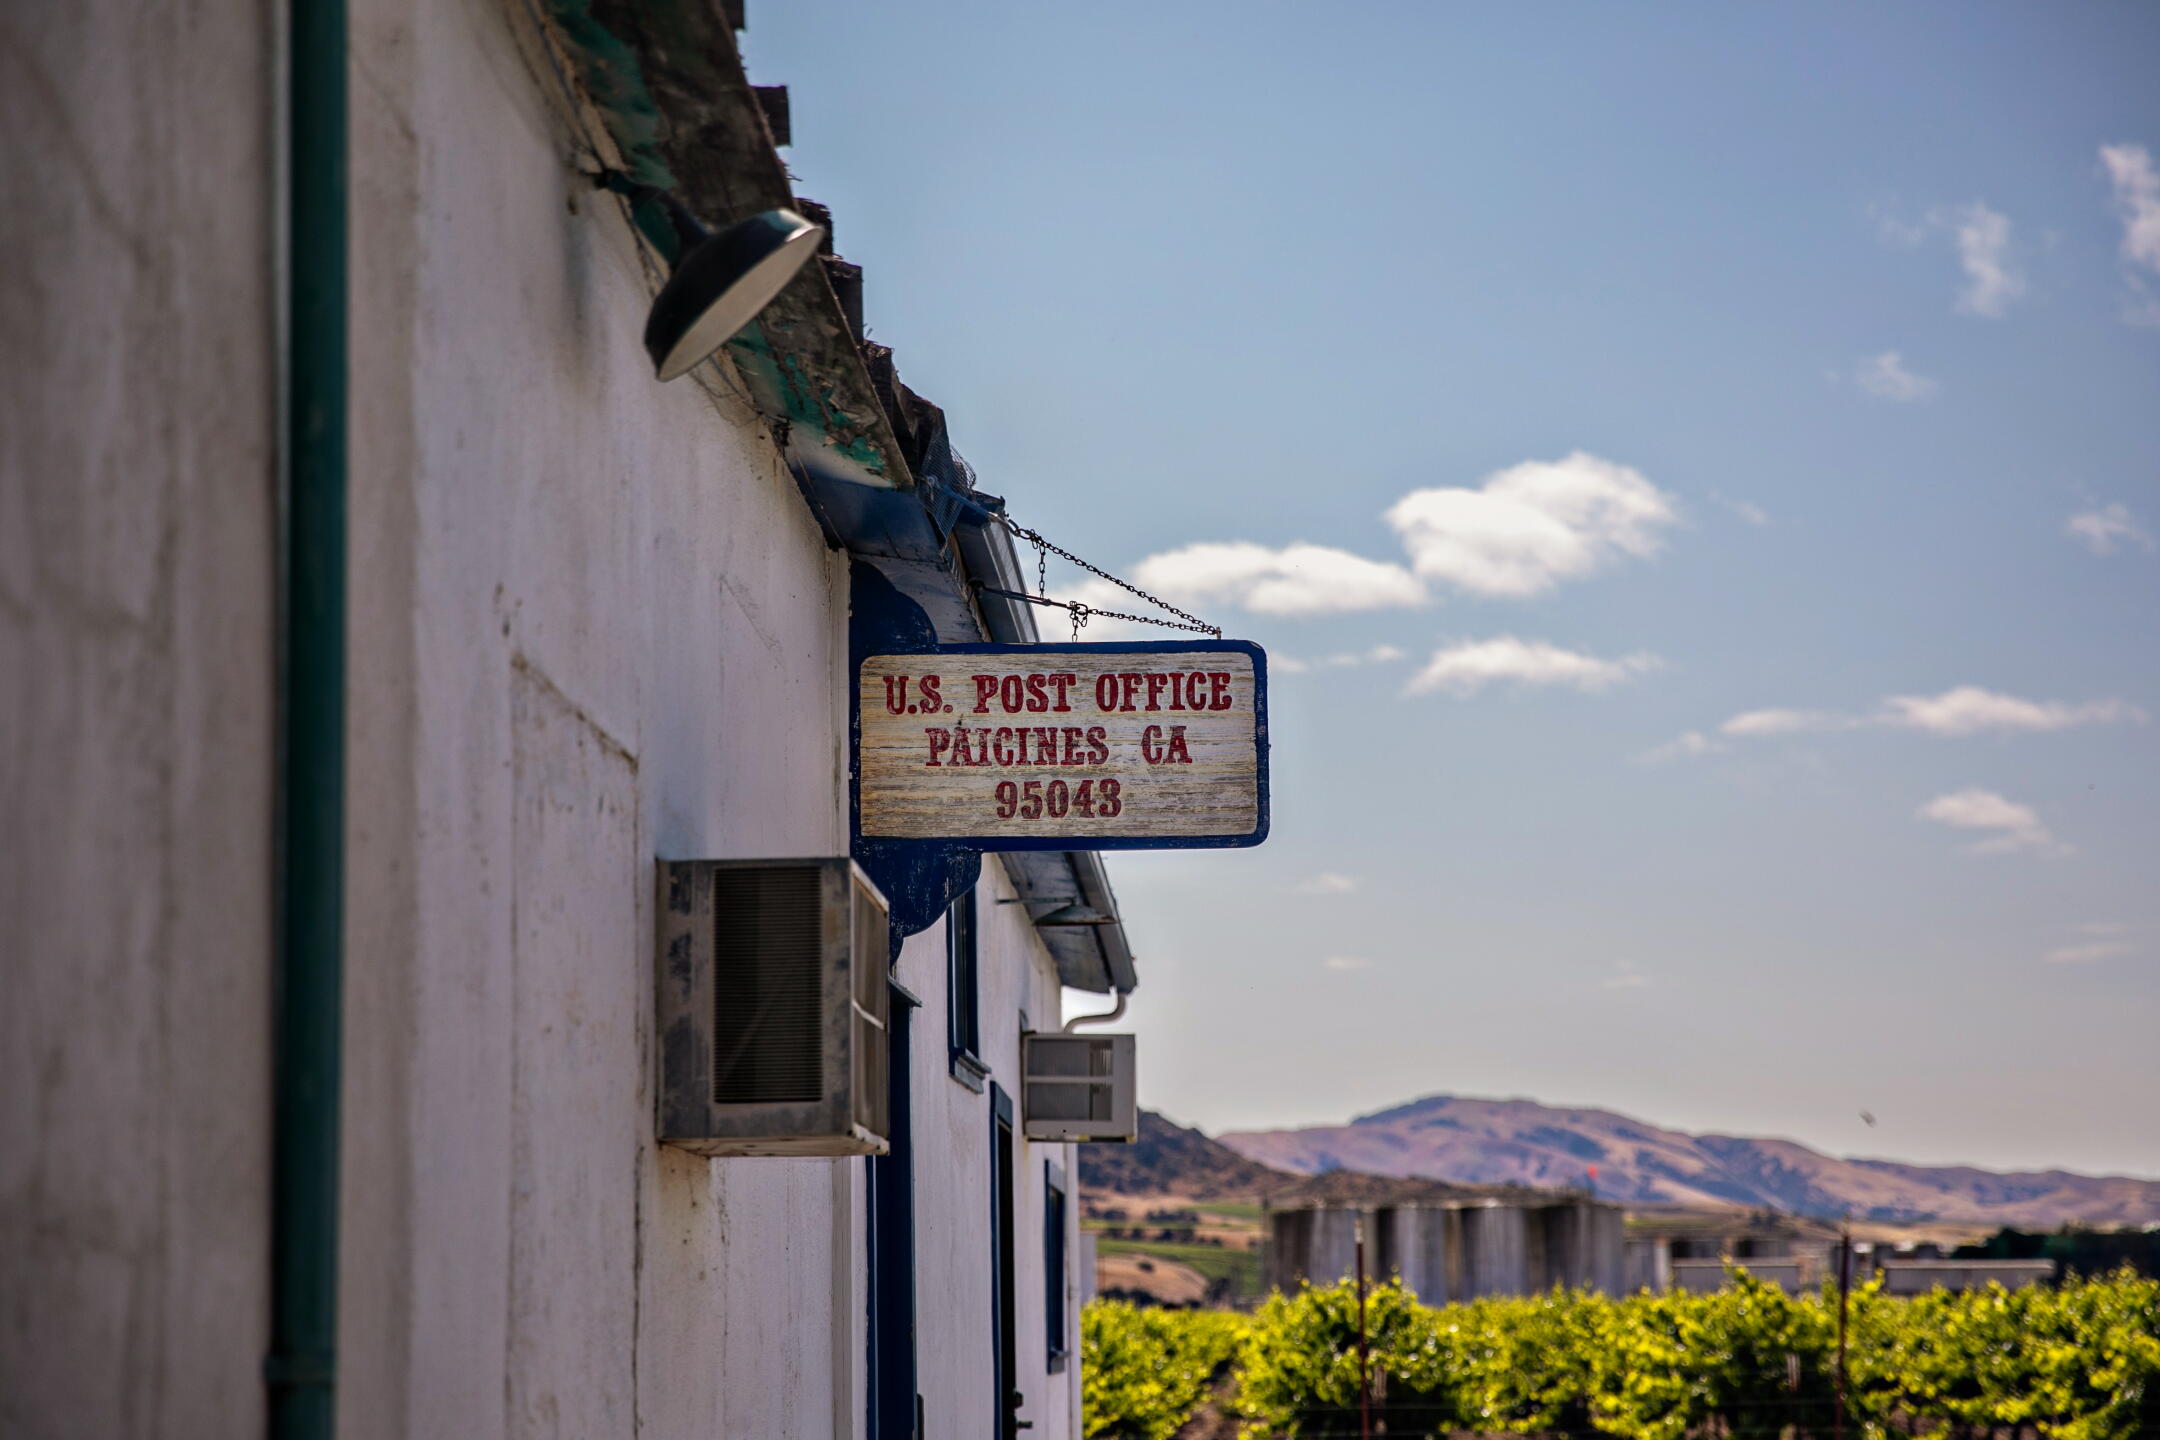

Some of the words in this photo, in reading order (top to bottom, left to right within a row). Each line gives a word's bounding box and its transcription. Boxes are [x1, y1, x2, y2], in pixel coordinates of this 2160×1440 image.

[882, 674, 954, 715] U.S.
[972, 673, 1076, 714] POST
[1095, 671, 1233, 712] OFFICE
[925, 726, 1110, 767] PAICINES
[1141, 724, 1193, 765] CA
[994, 777, 1123, 820] 95043
